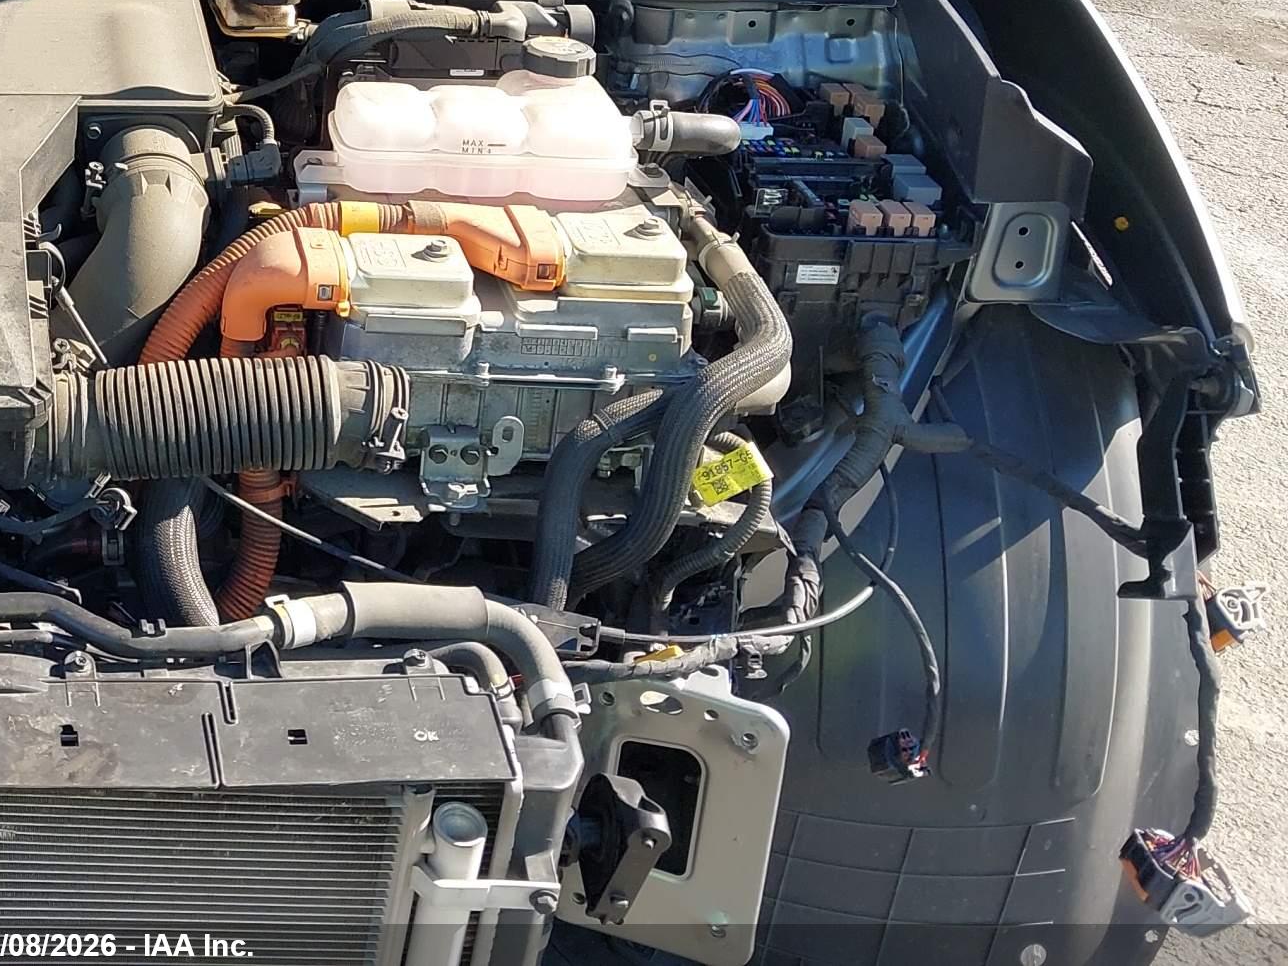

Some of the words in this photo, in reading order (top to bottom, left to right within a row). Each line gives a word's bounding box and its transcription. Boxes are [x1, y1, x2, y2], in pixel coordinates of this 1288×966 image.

[462, 139, 484, 147] MAX
[462, 146, 483, 154] MIN
[413, 730, 439, 742] OK
